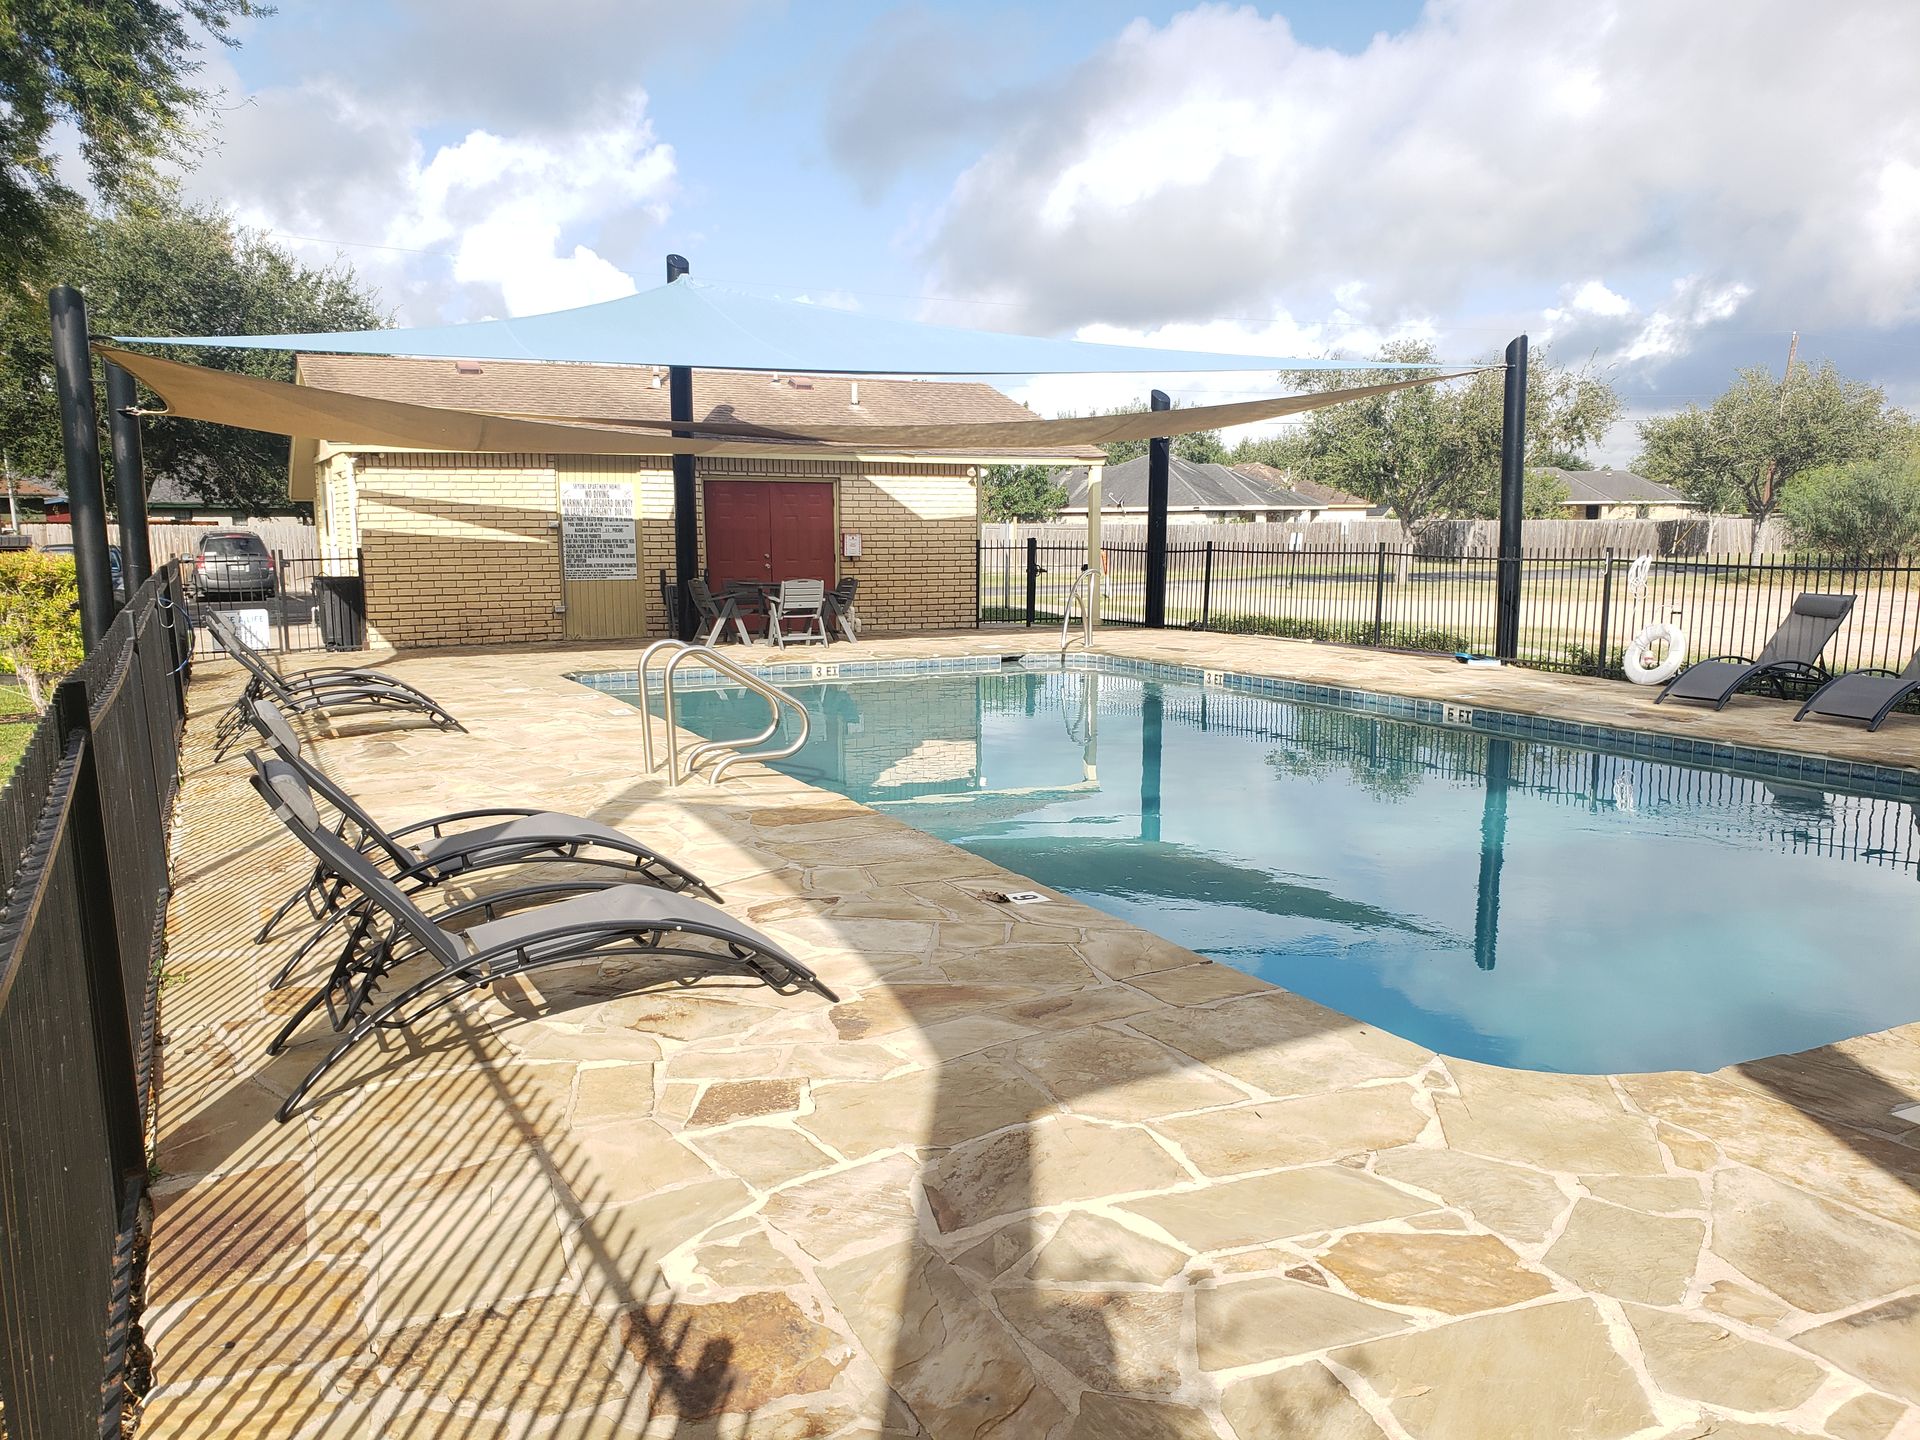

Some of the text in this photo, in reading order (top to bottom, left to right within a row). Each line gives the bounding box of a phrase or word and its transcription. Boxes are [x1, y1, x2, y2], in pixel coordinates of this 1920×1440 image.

[585, 490, 610, 498] NO DIVING
[584, 499, 590, 507] NO
[591, 499, 614, 508] LIFEGUARD
[246, 615, 264, 623] LIFE
[816, 667, 822, 677] 3
[1206, 672, 1212, 684] 3
